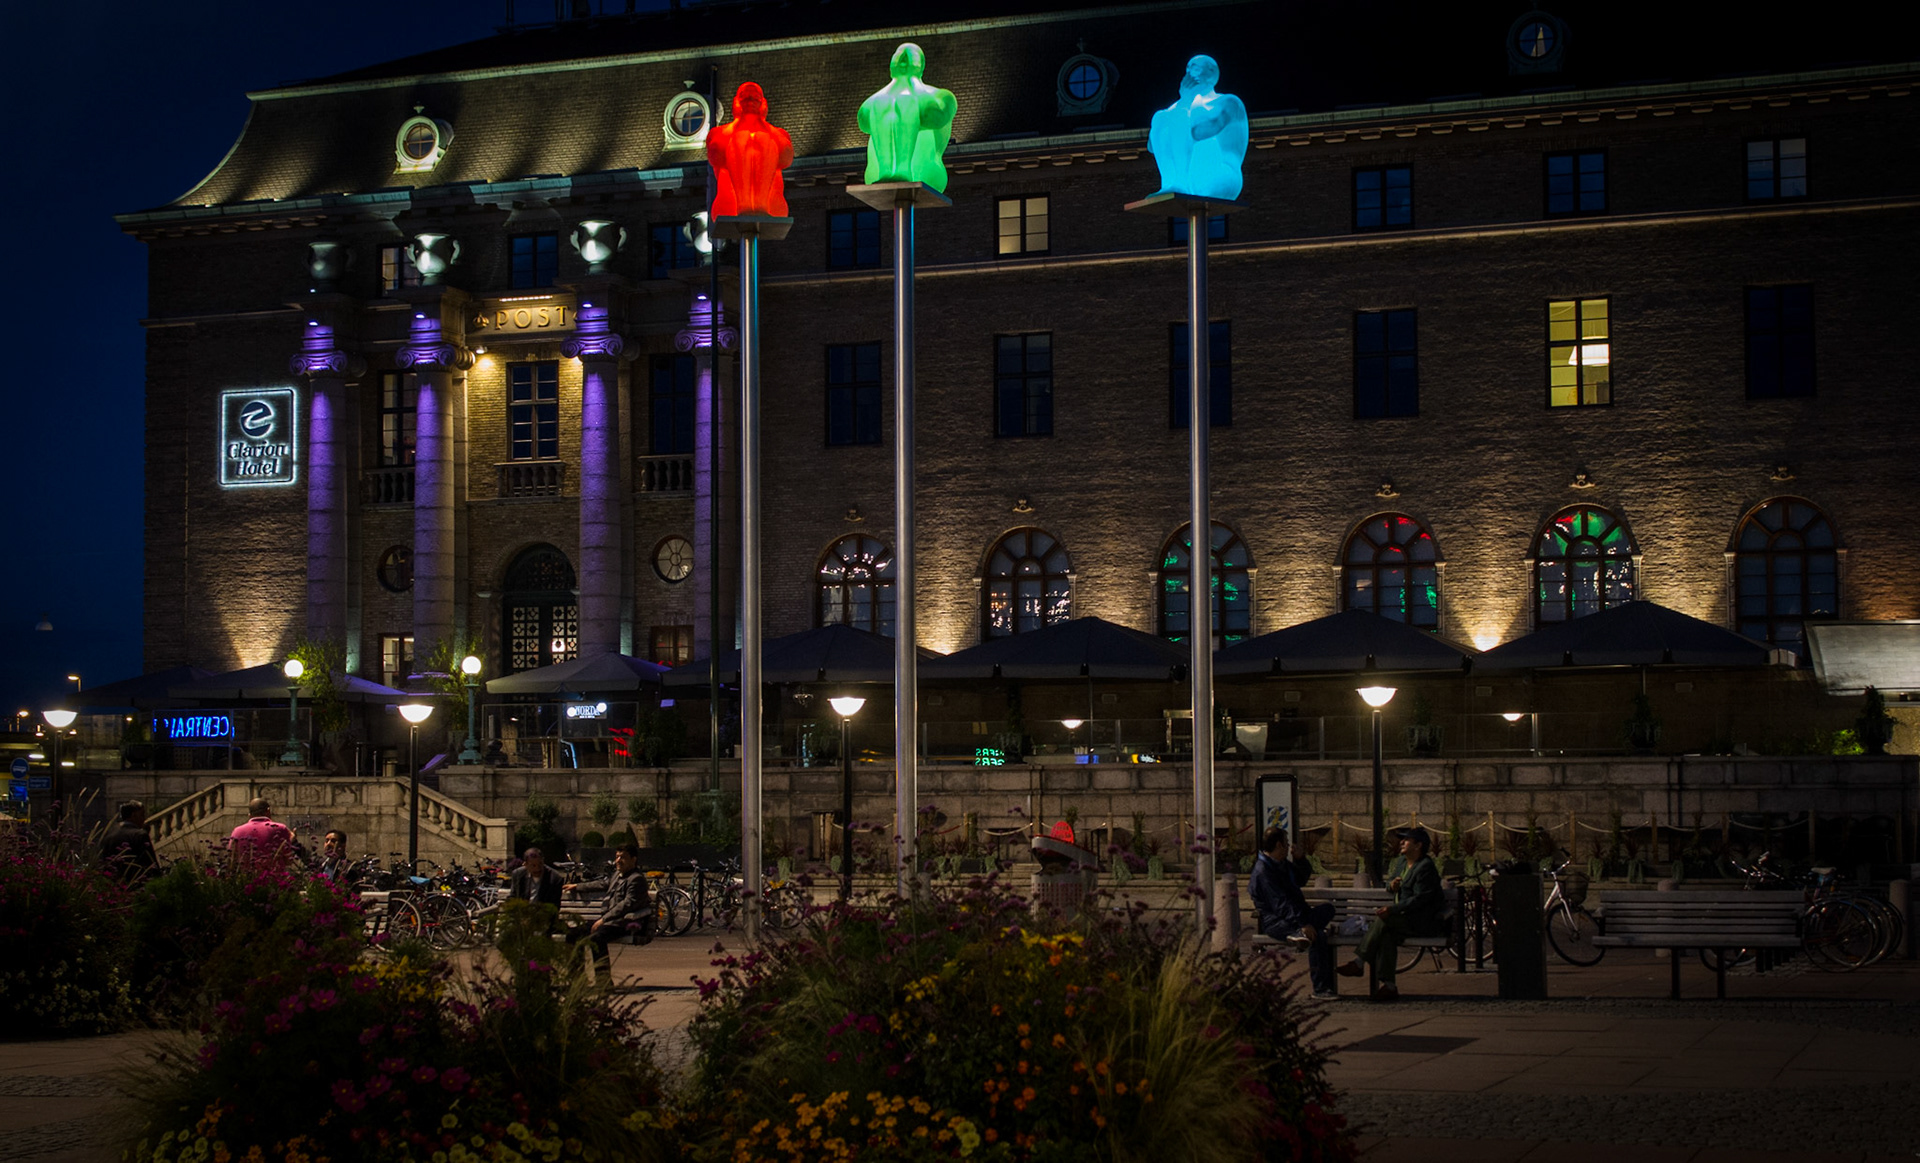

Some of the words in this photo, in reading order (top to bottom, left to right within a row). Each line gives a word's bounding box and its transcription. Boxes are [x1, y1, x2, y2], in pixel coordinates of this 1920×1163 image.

[495, 305, 569, 330] POST
[227, 439, 287, 458] Clarion
[236, 459, 279, 475] Hotel
